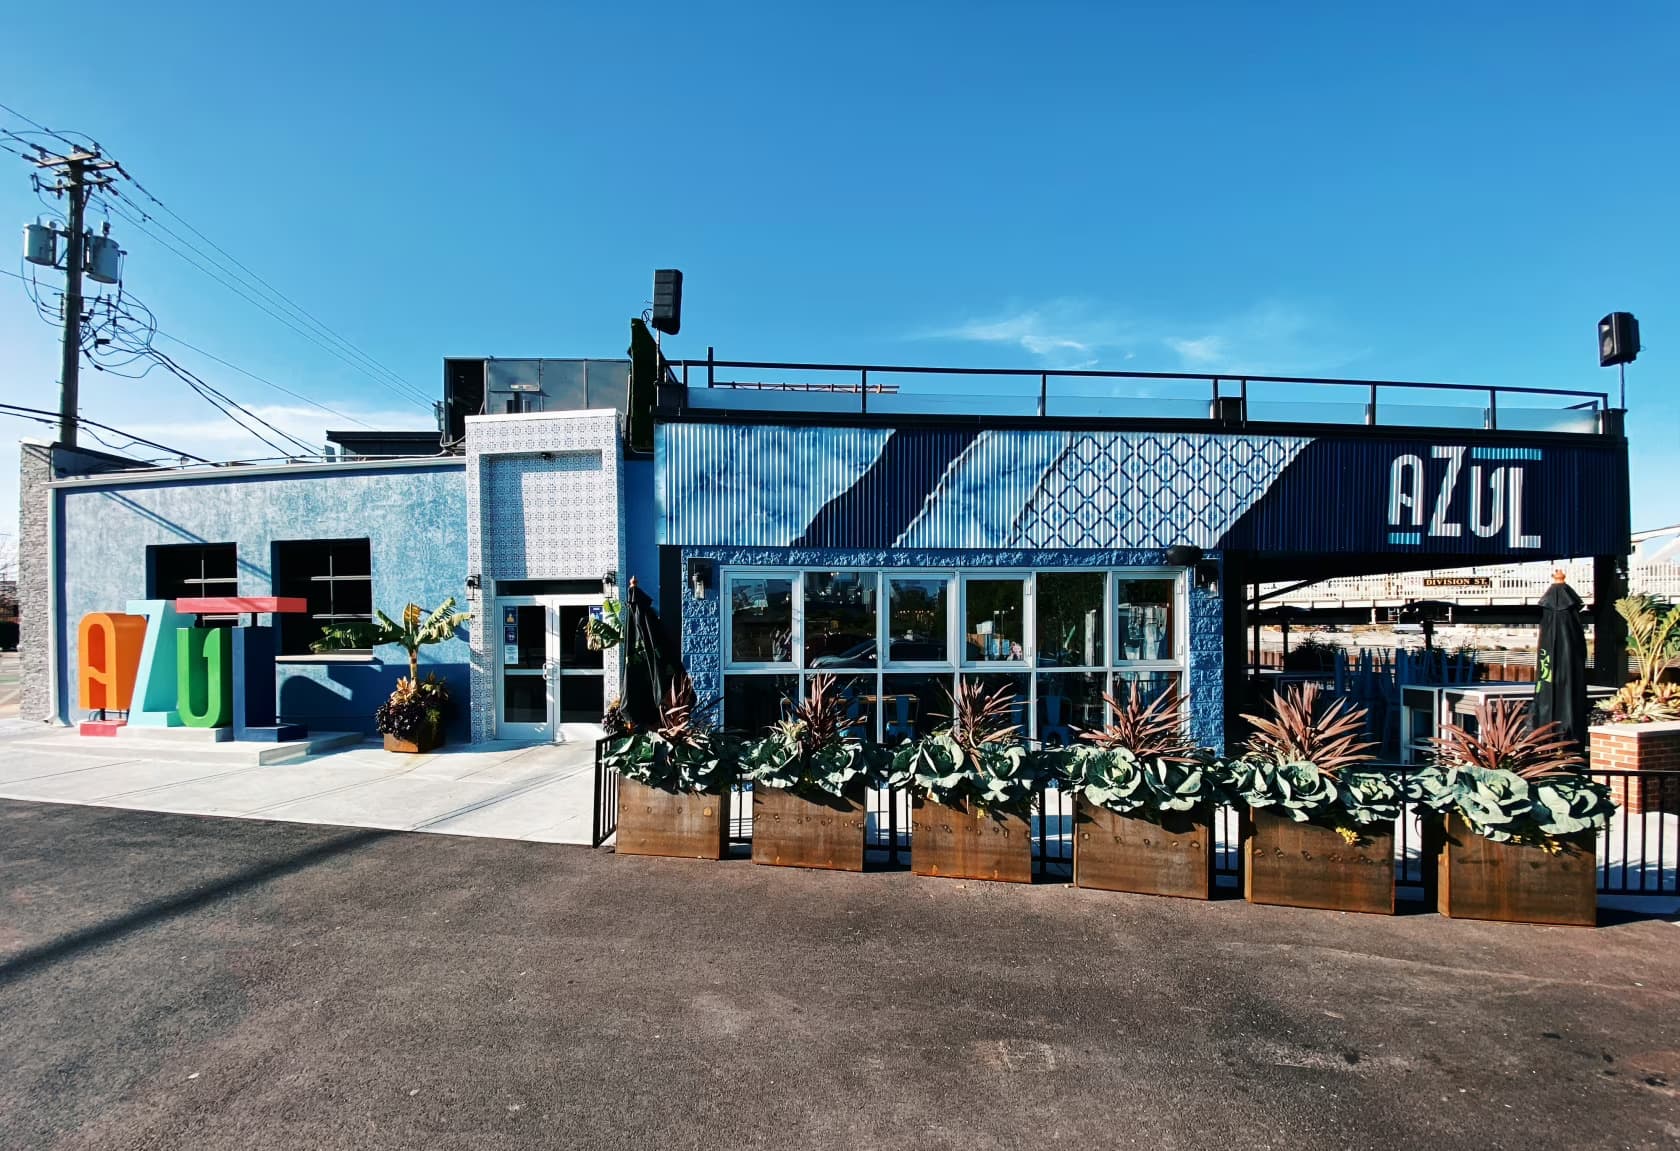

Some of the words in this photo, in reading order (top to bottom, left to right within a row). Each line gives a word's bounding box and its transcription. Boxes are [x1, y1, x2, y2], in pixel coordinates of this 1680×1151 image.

[1388, 446, 1542, 549] AZUL
[1426, 578, 1470, 586] DIVISION
[79, 598, 300, 742] AZUL
